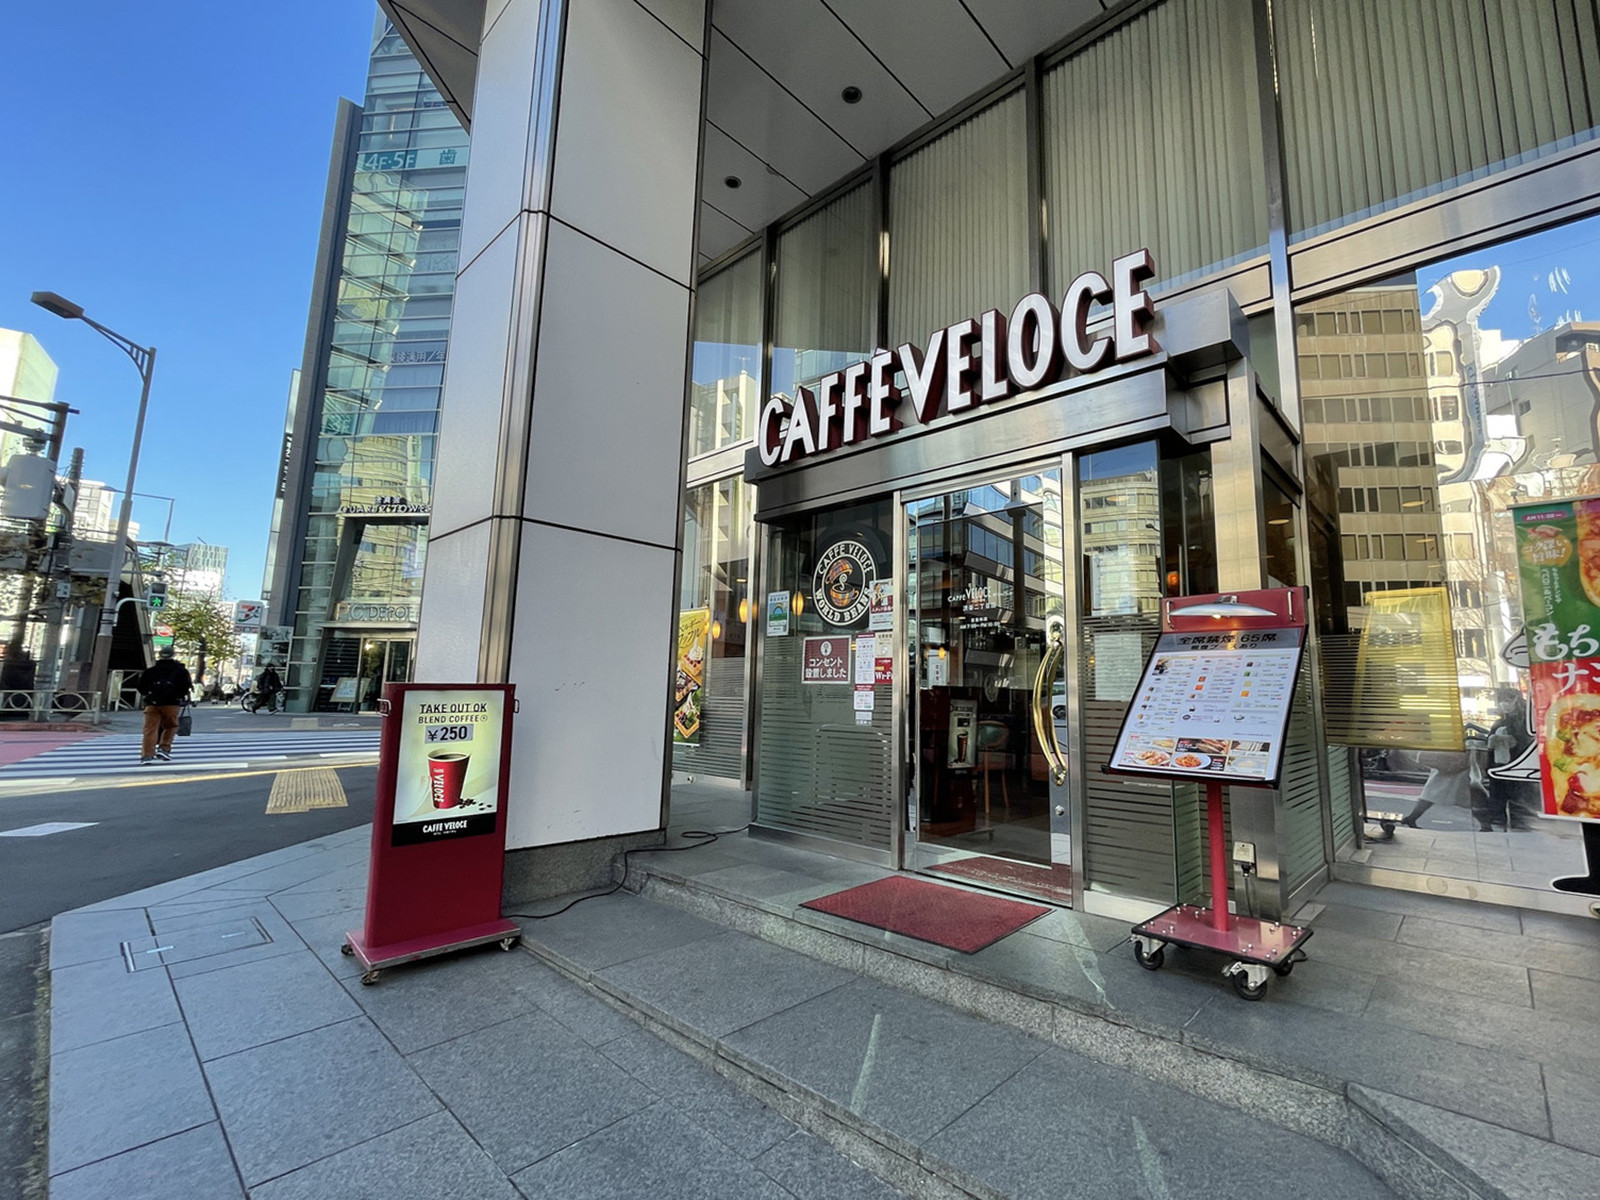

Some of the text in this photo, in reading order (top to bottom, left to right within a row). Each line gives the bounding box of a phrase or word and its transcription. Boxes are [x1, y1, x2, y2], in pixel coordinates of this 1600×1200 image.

[897, 247, 1156, 424] VELOCE
[818, 544, 873, 575] CAFFE VELOCE
[815, 588, 841, 622] WORLD
[1178, 633, 1277, 646] 全席禁煙 65席
[809, 656, 844, 668] コンセント
[805, 667, 847, 679] 設置しました
[420, 703, 487, 713] TAKE OUT OK
[418, 715, 447, 723] BLEND
[428, 726, 468, 741] ¥250
[433, 774, 445, 803] VELOCE
[444, 820, 468, 831] VELOCE
